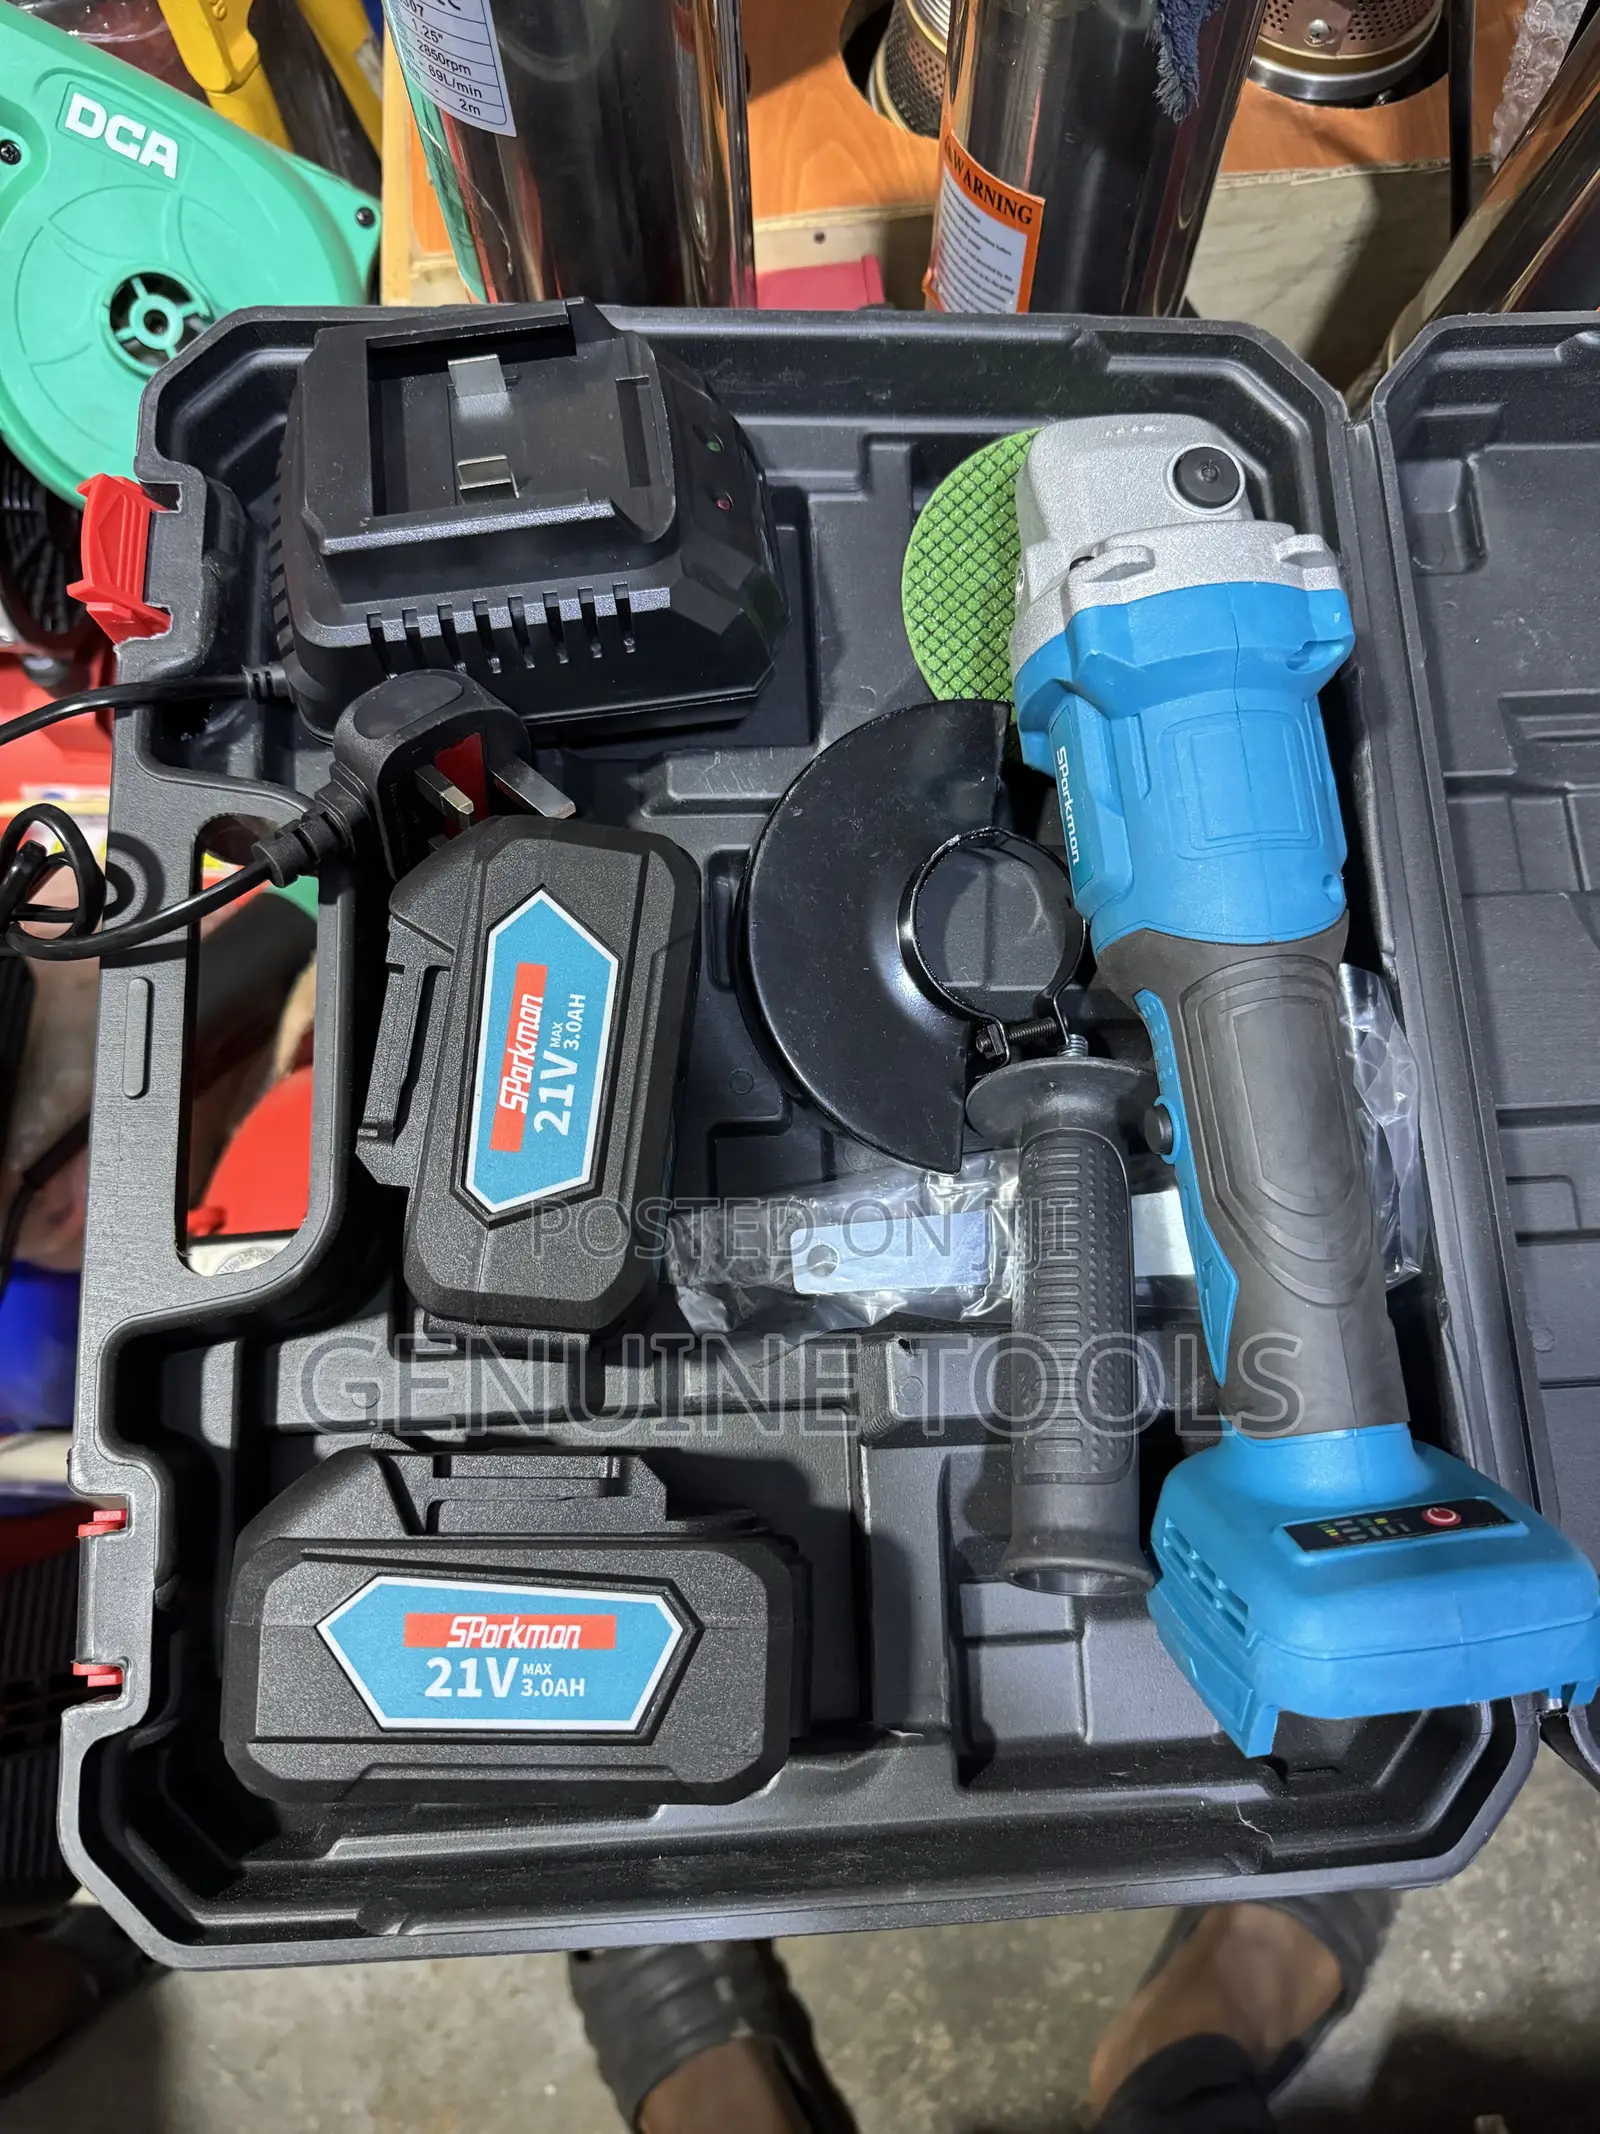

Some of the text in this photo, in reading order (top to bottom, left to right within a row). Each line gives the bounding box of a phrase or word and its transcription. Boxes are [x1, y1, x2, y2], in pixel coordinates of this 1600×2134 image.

[416, 39, 472, 76] 2850rpm
[428, 64, 483, 99] 69L/min
[459, 98, 481, 116] 2m
[64, 91, 179, 180] DCA
[952, 157, 1033, 226] WARNING
[550, 1021, 563, 1048] MAX
[563, 993, 586, 1051] 3.0AH
[533, 1049, 578, 1136] 21V
[424, 1656, 552, 1698] 21V MAX
[520, 1677, 585, 1697] 3.0AH
